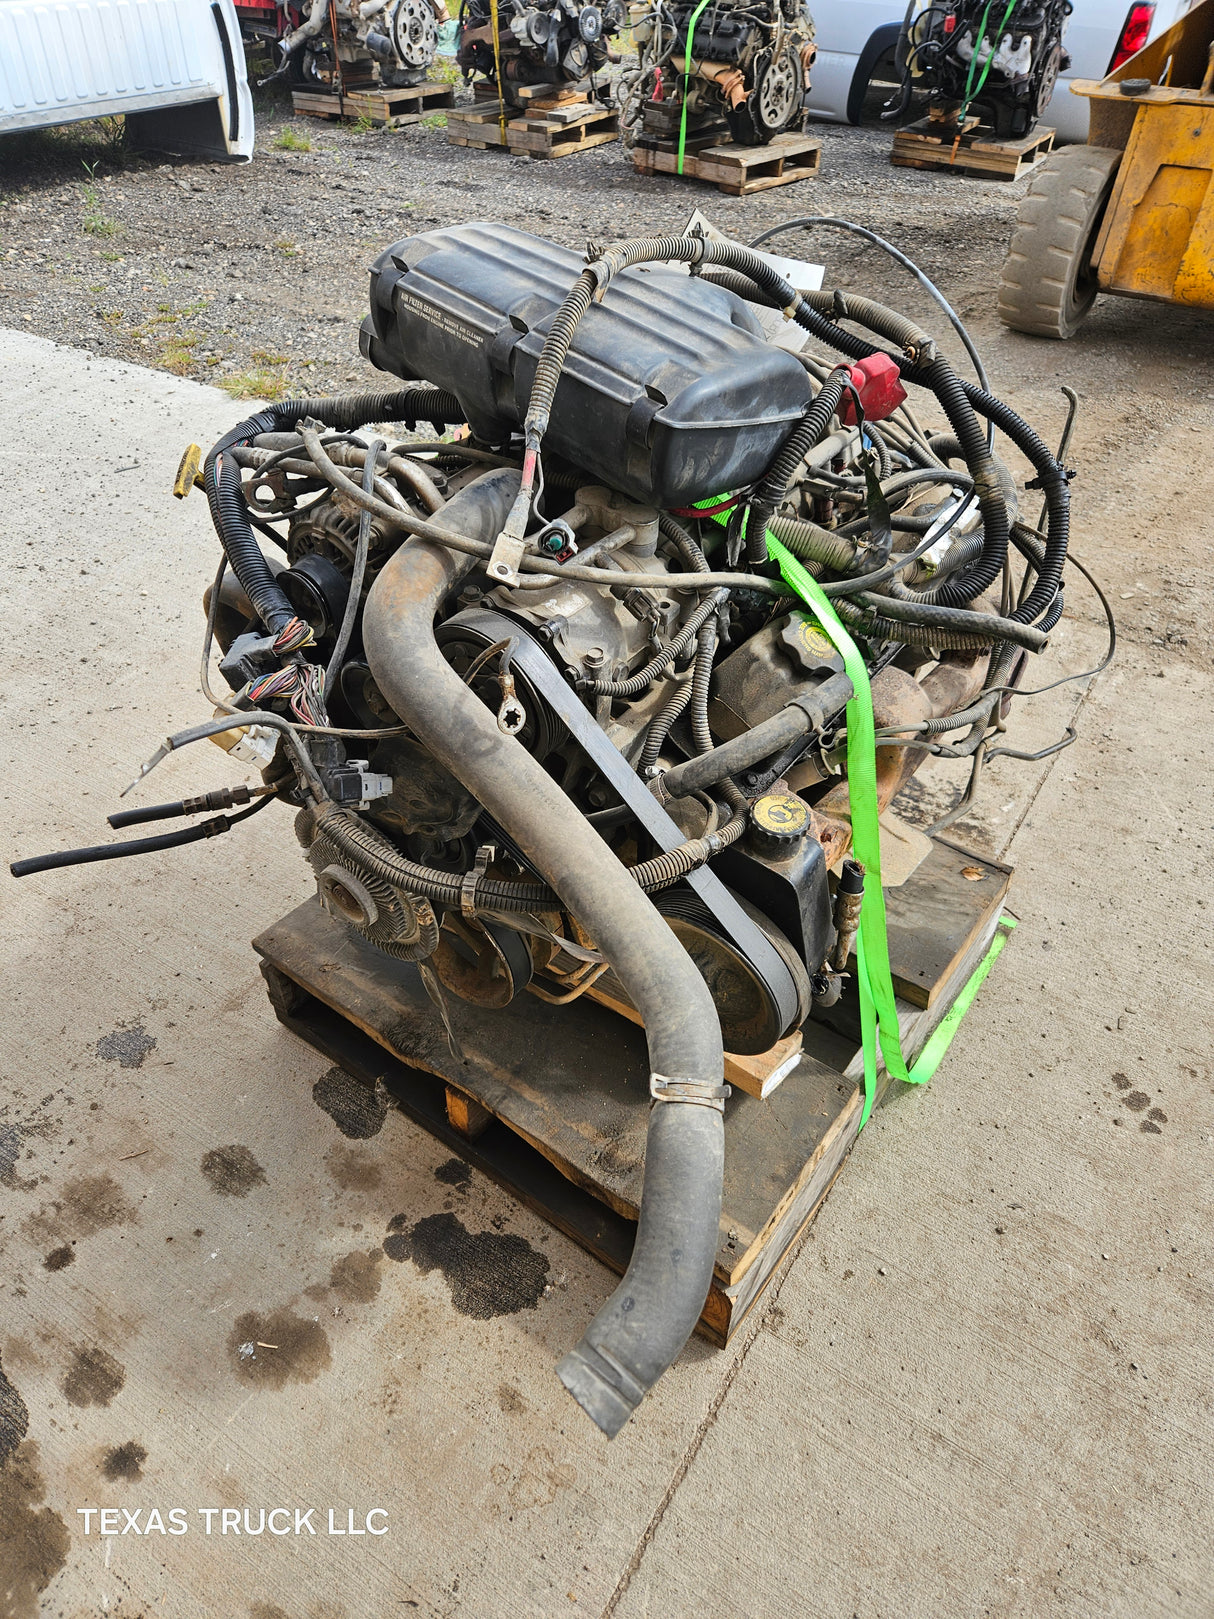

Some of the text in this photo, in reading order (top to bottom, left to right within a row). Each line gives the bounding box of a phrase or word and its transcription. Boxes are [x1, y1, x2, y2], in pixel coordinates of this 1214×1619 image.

[401, 292, 409, 302] AIR
[409, 296, 423, 310] FILTER
[423, 302, 441, 320] SERVICE
